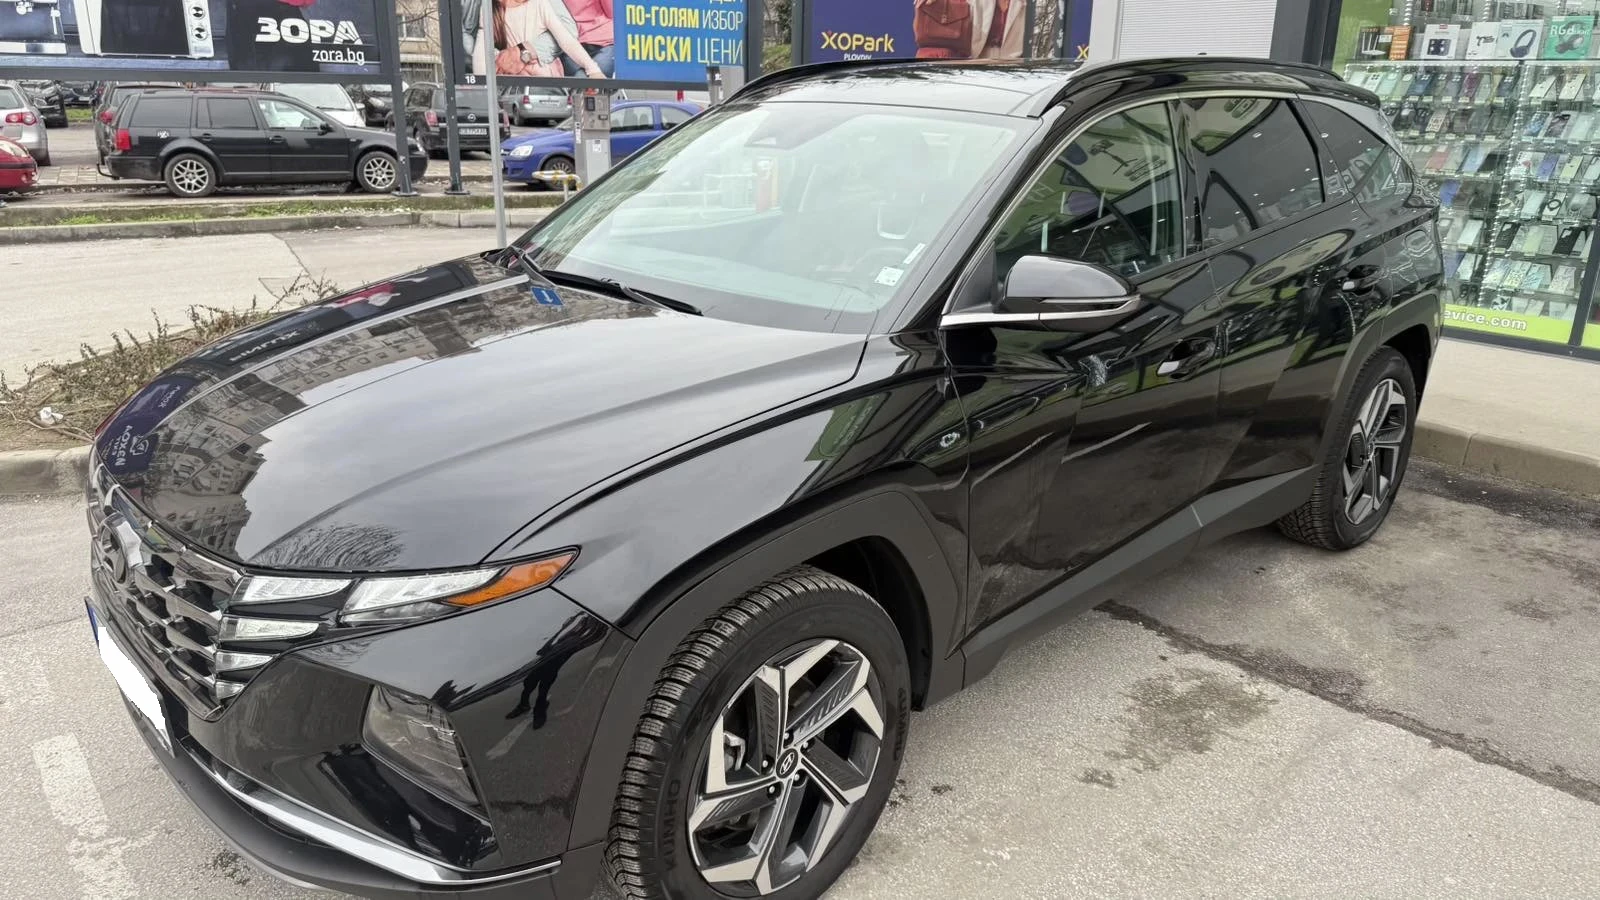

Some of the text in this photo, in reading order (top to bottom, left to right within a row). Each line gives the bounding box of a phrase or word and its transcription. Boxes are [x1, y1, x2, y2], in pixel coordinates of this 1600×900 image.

[626, 4, 743, 31] ПО-ГОЛЯМ ИЗБОР
[255, 17, 363, 45] ЗОРА
[820, 31, 895, 53] XOPark
[312, 48, 365, 66] zora.bg
[627, 33, 743, 65] НИСКИ ЦЕНИ
[465, 75, 476, 84] 18
